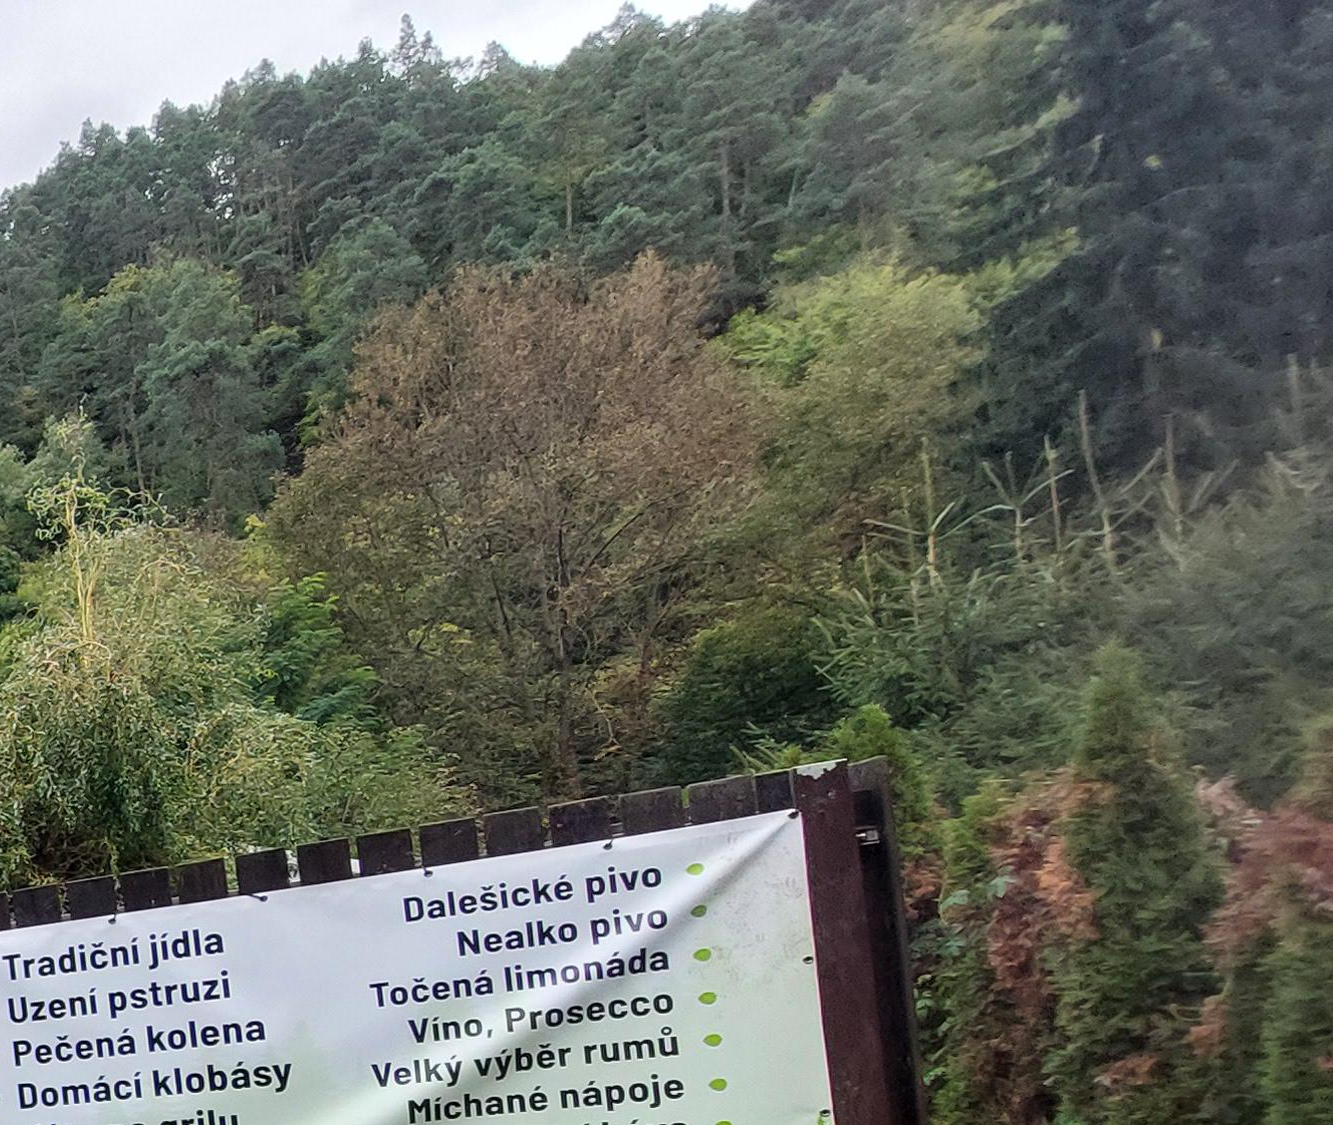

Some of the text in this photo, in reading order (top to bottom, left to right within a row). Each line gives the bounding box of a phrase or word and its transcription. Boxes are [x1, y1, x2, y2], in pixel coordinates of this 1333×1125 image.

[403, 866, 662, 923] Dalešické pivo
[3, 928, 224, 981] Tradiční jídla
[457, 909, 668, 956] Nealko pivo
[8, 970, 231, 1023] Uzení pstruzi
[370, 948, 670, 1008] Točená limonáda
[12, 1019, 266, 1066] Pečená kolena
[408, 993, 674, 1044] Víno, Prosecco
[371, 1026, 680, 1089] Velký výběr rumů
[17, 1061, 292, 1110] Domácí klobásy
[408, 1074, 685, 1125] Míchané nápoje
